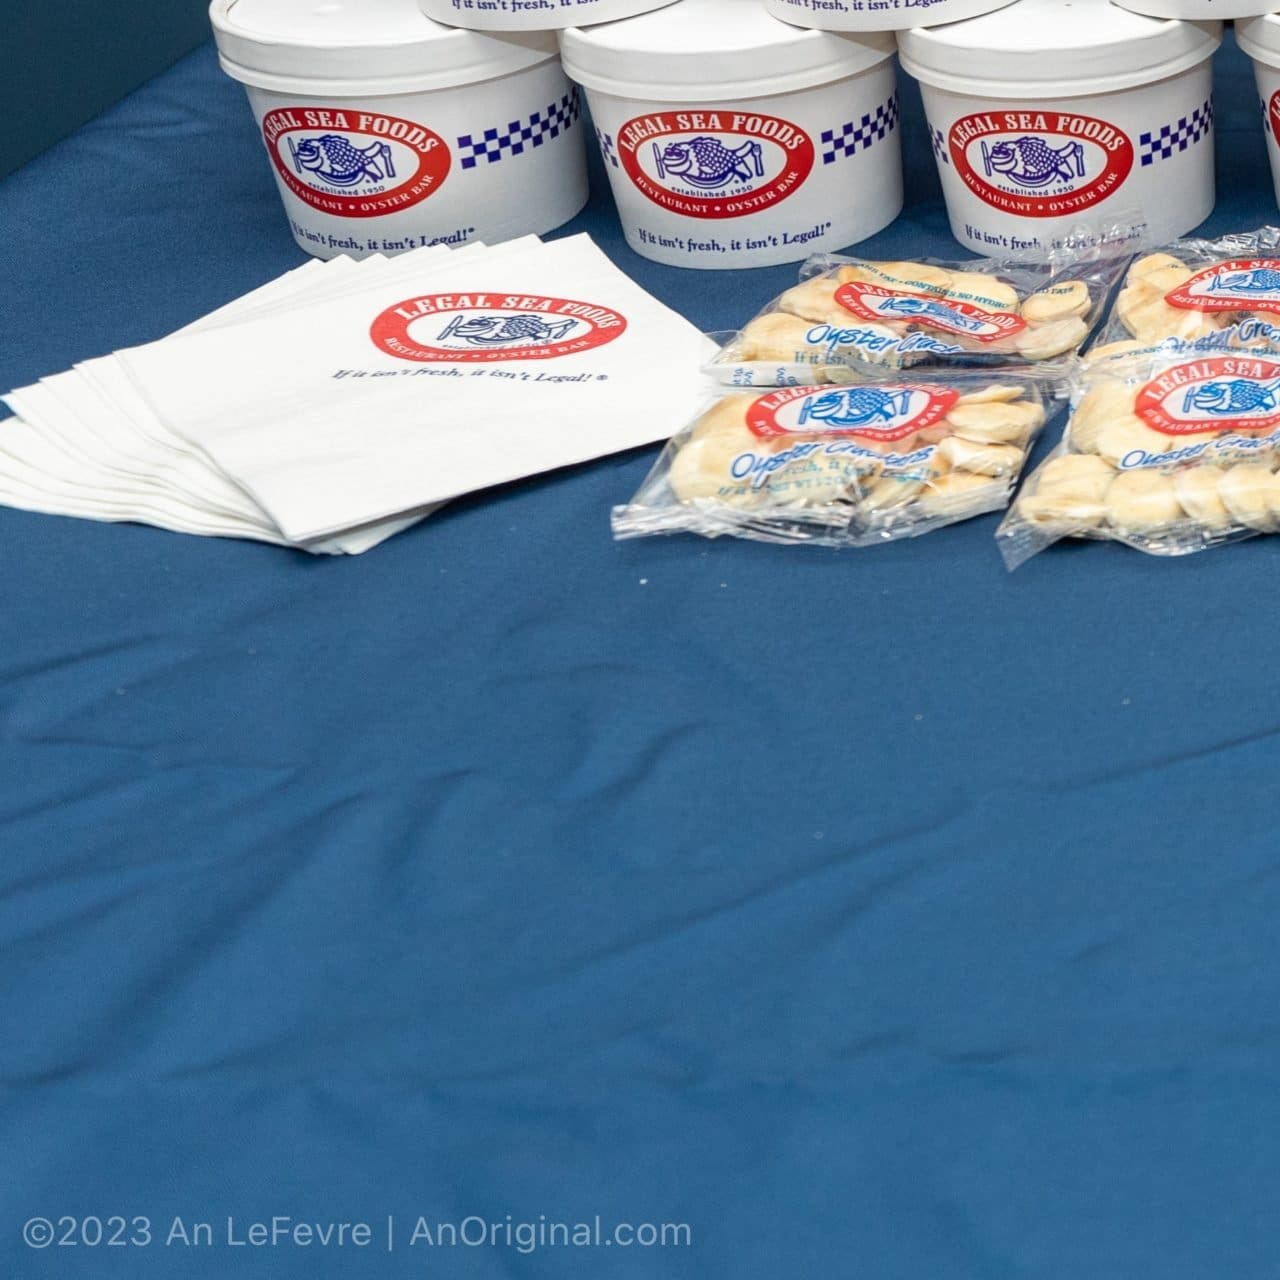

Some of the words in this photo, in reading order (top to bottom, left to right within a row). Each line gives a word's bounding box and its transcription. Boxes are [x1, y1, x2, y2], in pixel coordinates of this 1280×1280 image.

[265, 111, 301, 144] LEGAL
[304, 111, 349, 129] SEA
[358, 113, 439, 153] FOODS
[621, 117, 672, 153] LEGAL
[677, 113, 723, 131] SEA
[732, 116, 806, 151] FOODS
[952, 116, 1000, 151] LEGAL
[1004, 113, 1048, 131] SEA
[1056, 116, 1125, 152] FOODS
[361, 192, 410, 211] OYSTER
[412, 174, 434, 195] BAR
[636, 176, 708, 213] RESTAURANT
[727, 191, 776, 212] OYSTER
[777, 170, 799, 193] BAR
[965, 172, 1032, 212] RESTAURANT
[1049, 190, 1096, 211] OYSTER
[1099, 172, 1118, 193] BAR
[392, 295, 492, 321] LEGAL
[501, 297, 553, 312] SEA
[557, 302, 621, 330] FOODS
[556, 340, 590, 353] BAR
[806, 325, 899, 354] Oyster
[1145, 362, 1215, 401] LEGAL
[1223, 361, 1262, 377] SEA
